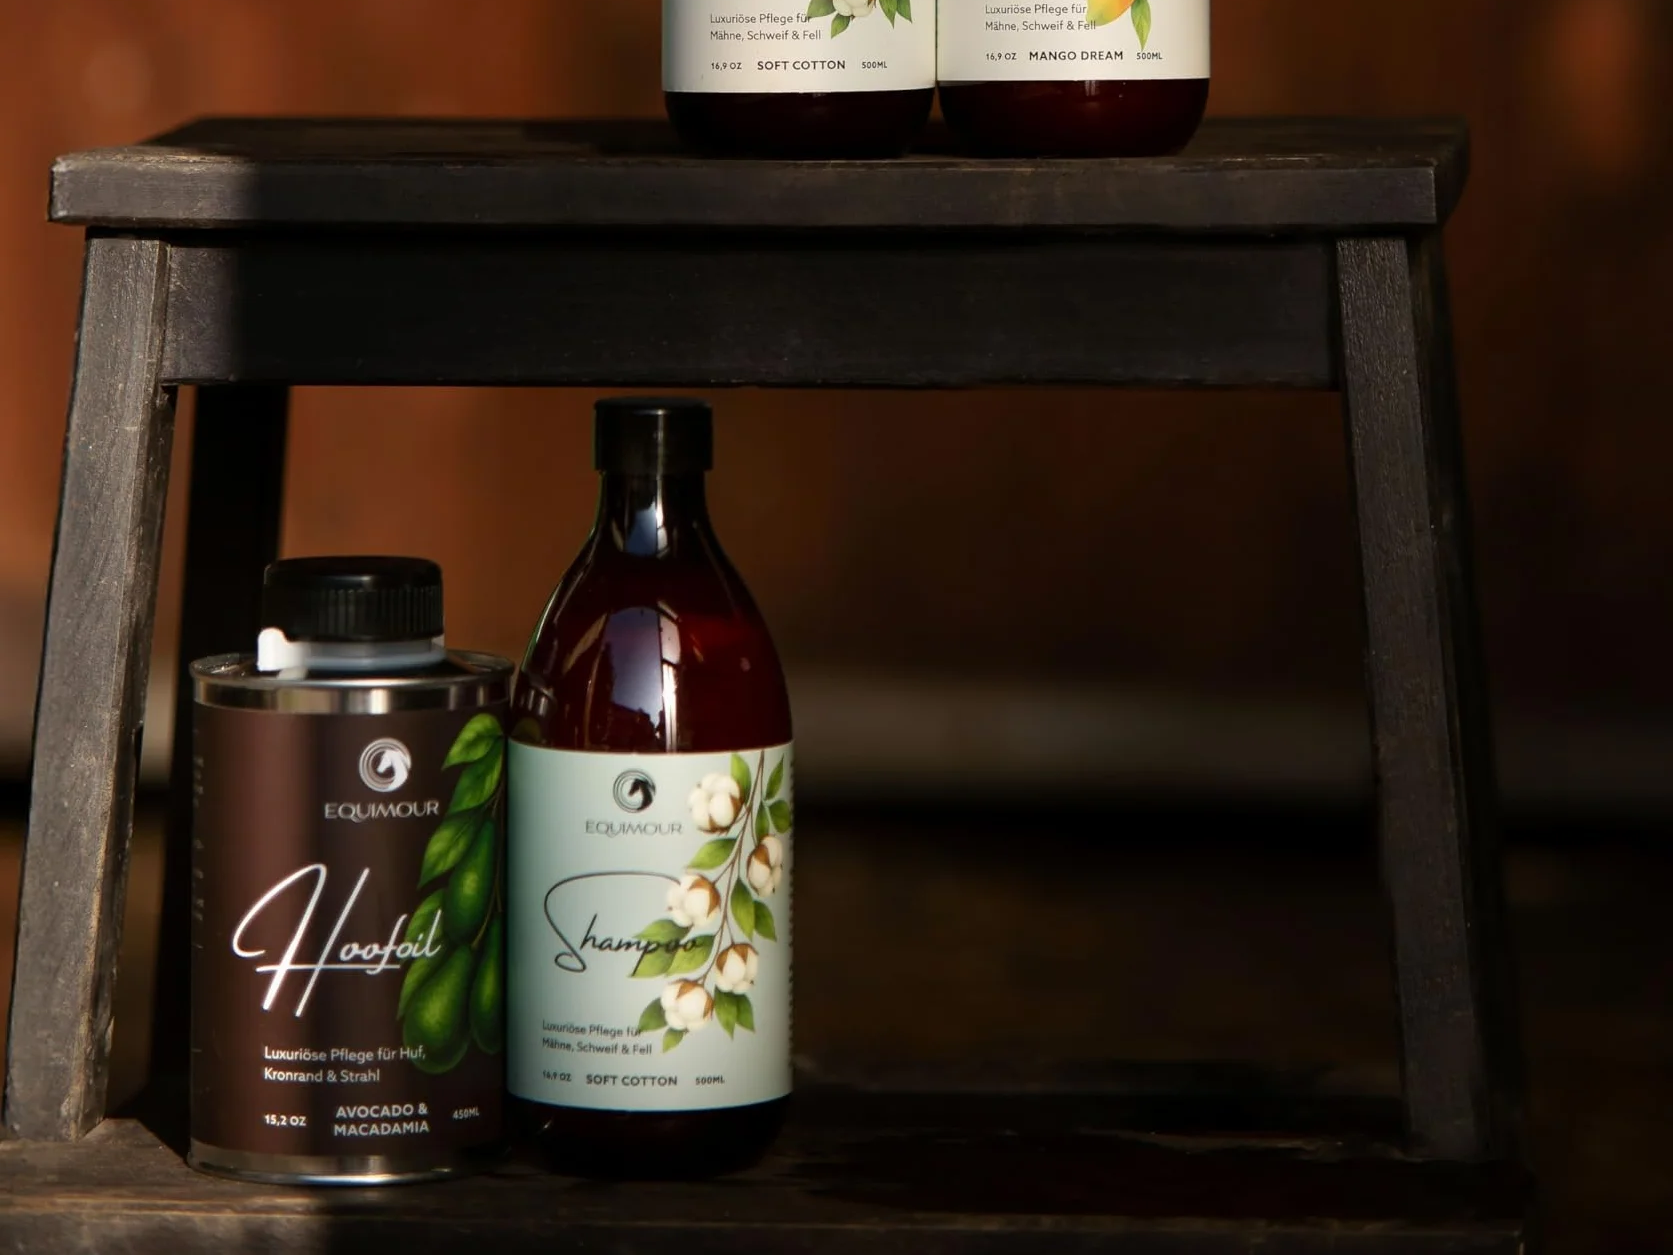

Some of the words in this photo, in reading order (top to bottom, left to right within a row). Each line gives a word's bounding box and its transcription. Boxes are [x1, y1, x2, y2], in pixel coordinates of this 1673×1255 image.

[984, 3, 1032, 15] Luxuriöse
[1034, 3, 1069, 18] Pflege
[1070, 3, 1087, 14] für
[709, 12, 757, 25] Luxuriöse
[759, 12, 794, 28] Pflege
[795, 12, 812, 25] für
[985, 19, 1020, 33] Mähne,
[1022, 19, 1065, 32] Schweif
[1066, 21, 1076, 31] &
[1077, 20, 1097, 31] Fell
[709, 29, 745, 43] Mähne,
[746, 29, 789, 41] Schweif
[791, 30, 801, 41] &
[802, 29, 822, 41] Fell
[985, 52, 1004, 62] 16,9
[1004, 52, 1018, 61] OZ
[1028, 50, 1078, 61] MANGO
[1080, 50, 1124, 61] DREAM
[1135, 51, 1164, 61] 500ML
[710, 61, 729, 72] 16,9
[729, 61, 743, 70] OZ
[756, 60, 791, 71] SOFT
[792, 59, 846, 71] COTTON
[860, 60, 888, 70] 500ML
[323, 801, 440, 823] EQUIMOUR
[584, 819, 683, 838] EQUIMOUR
[543, 870, 705, 977] Shampoo
[231, 862, 445, 1018] Hoofoil
[542, 1019, 587, 1037] Luxuriöse
[588, 1023, 624, 1040] Pflege
[626, 1024, 643, 1037] für
[542, 1037, 575, 1053] Mähne,
[576, 1039, 619, 1055] Schweif
[620, 1043, 631, 1056] &
[632, 1042, 653, 1056] Fell
[263, 1045, 327, 1063] Luxuriöse
[329, 1047, 375, 1065] Pflege
[376, 1046, 397, 1061] für
[398, 1045, 426, 1062] Huf,
[263, 1067, 324, 1083] Kronrand
[326, 1069, 338, 1082] &
[339, 1068, 381, 1083] Strahl
[559, 1071, 572, 1082] OZ
[585, 1073, 619, 1087] SOFT
[620, 1075, 678, 1088] COTTON
[694, 1075, 726, 1086] 500ML
[335, 1104, 414, 1119] AVOCADO
[417, 1102, 429, 1116] &
[452, 1106, 480, 1120] 450ML
[263, 1113, 288, 1128] 15,2
[289, 1114, 307, 1127] OZ
[333, 1120, 430, 1137] MACADAMIA
